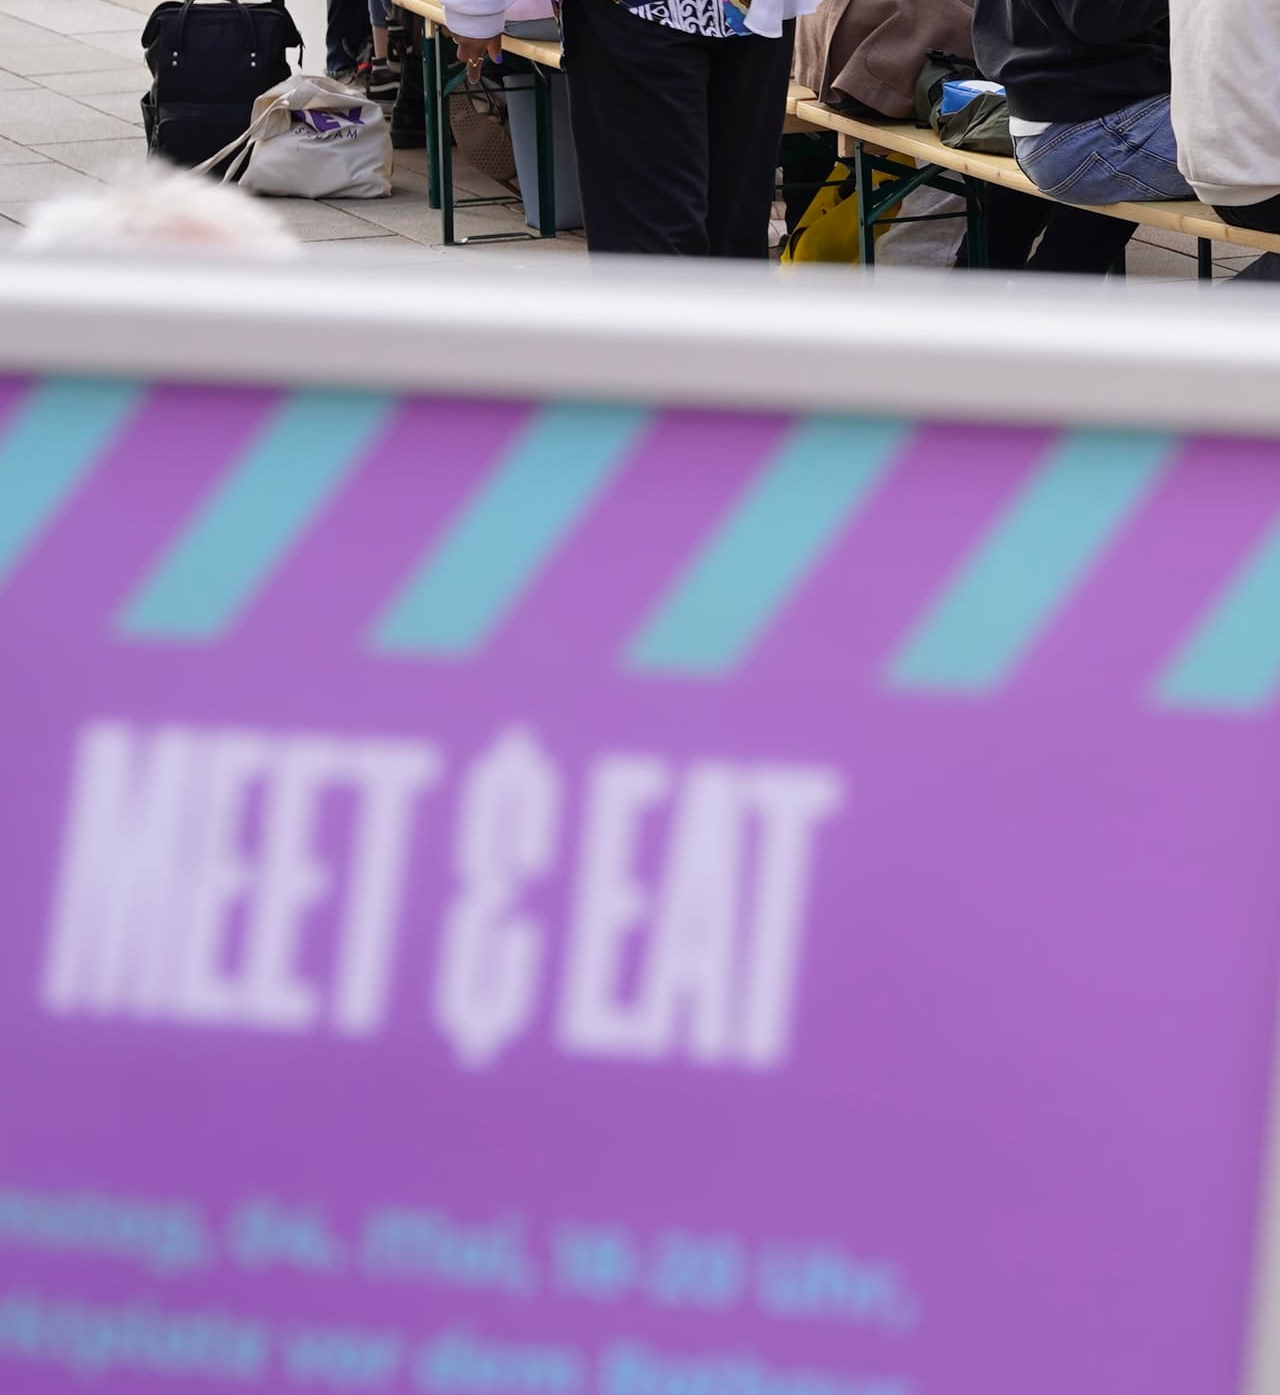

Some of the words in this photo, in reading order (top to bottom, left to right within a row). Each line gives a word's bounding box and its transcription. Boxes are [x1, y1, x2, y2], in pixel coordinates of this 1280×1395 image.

[44, 723, 441, 1034] MEET
[437, 723, 562, 1068] &
[557, 752, 844, 1068] EAT
